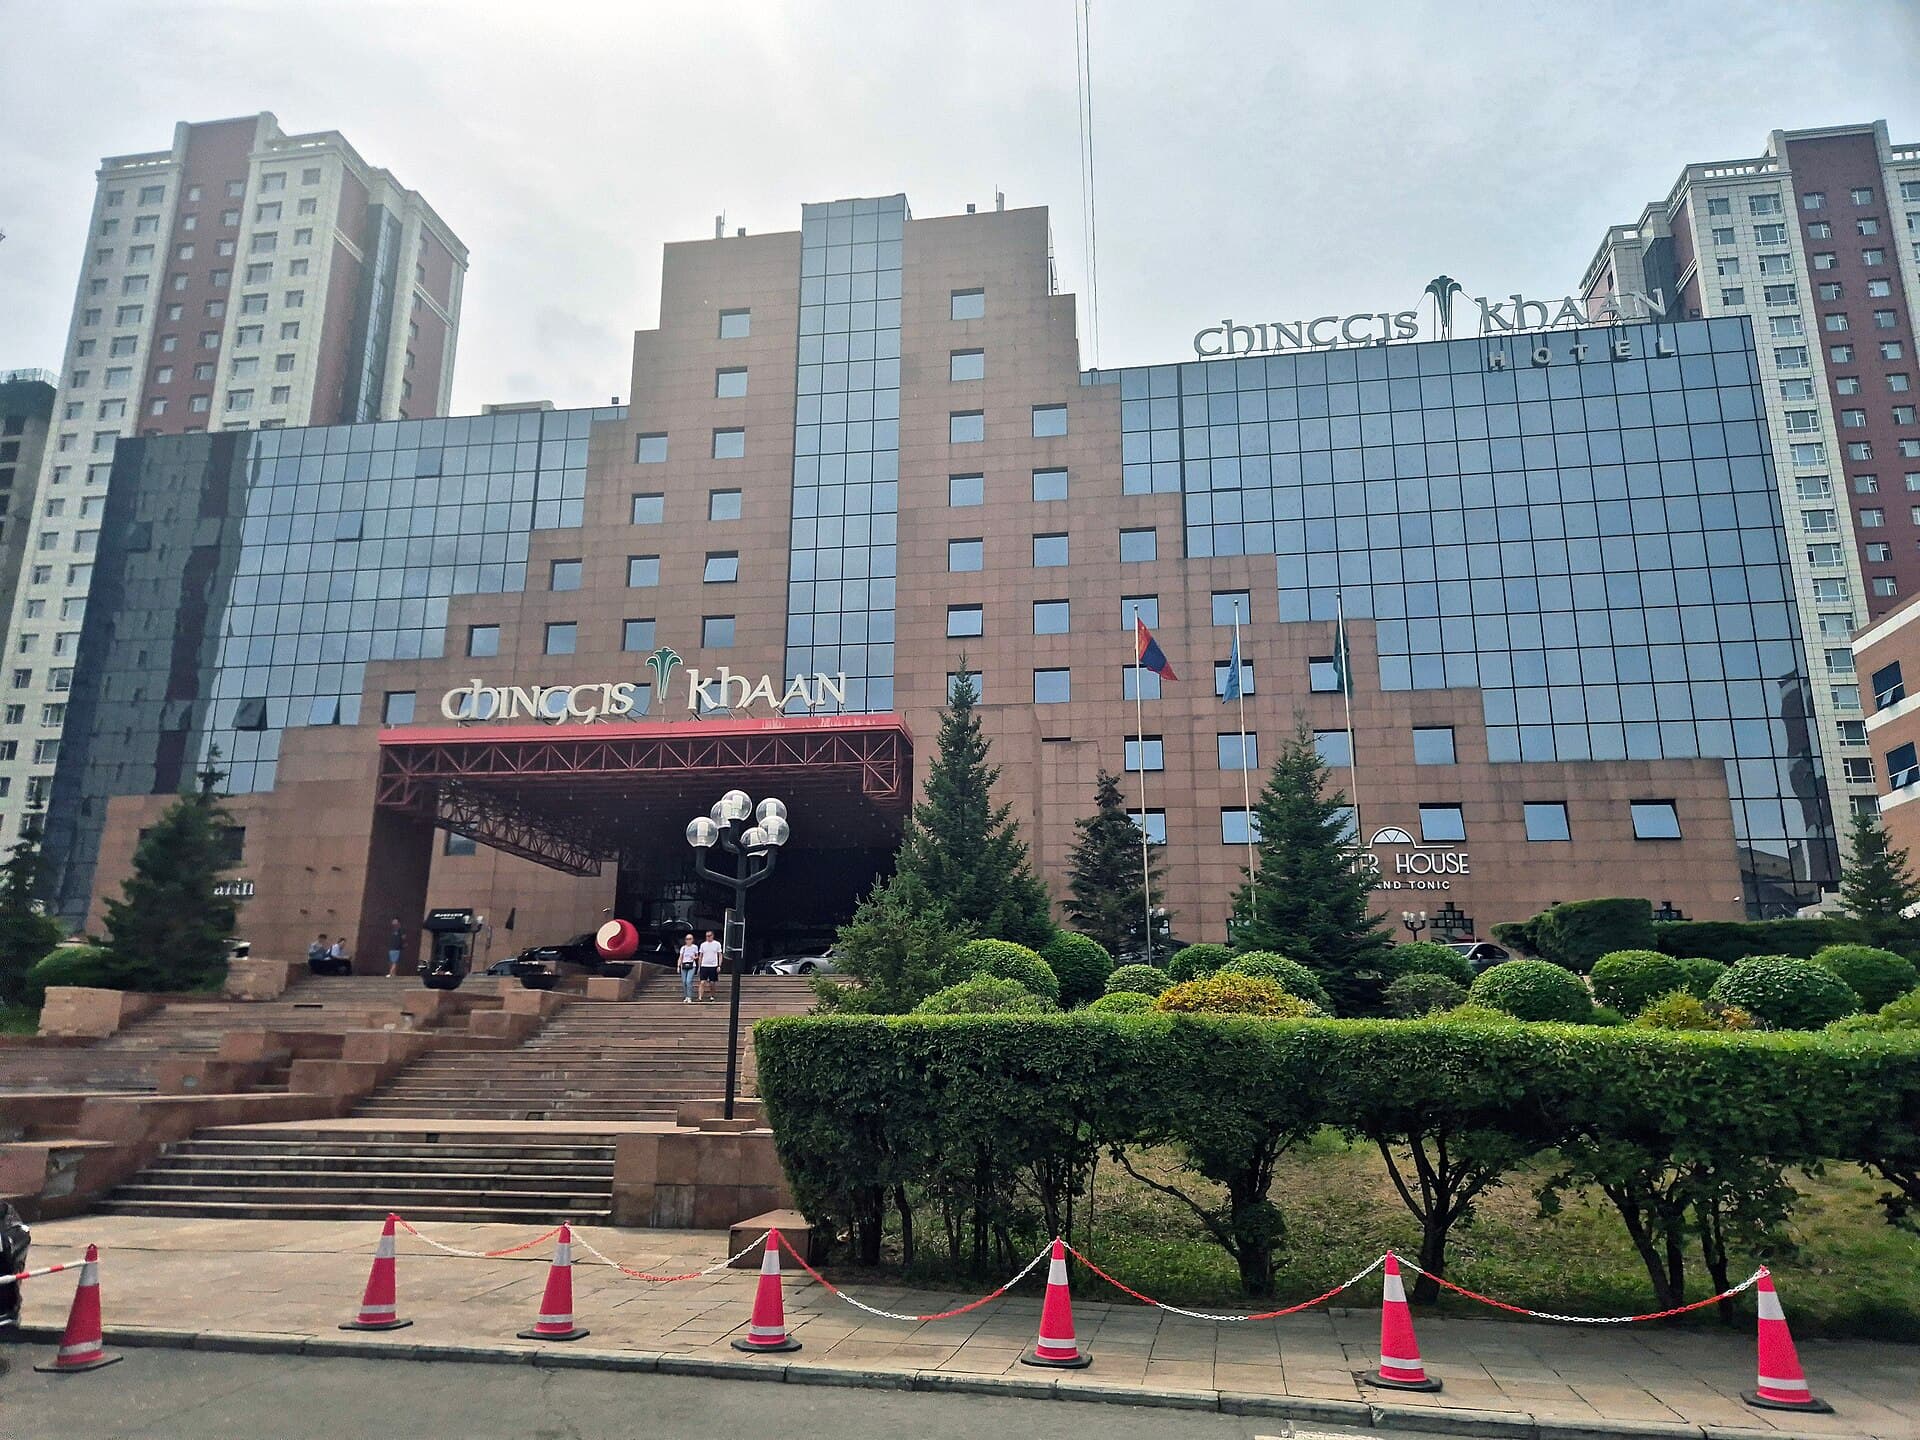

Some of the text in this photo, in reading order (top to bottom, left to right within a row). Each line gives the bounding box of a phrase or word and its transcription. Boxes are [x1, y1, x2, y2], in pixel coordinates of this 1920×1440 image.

[1489, 336, 1675, 371] HOTEL
[1336, 852, 1471, 875] TER HOUSE
[1408, 880, 1451, 890] TONIC
